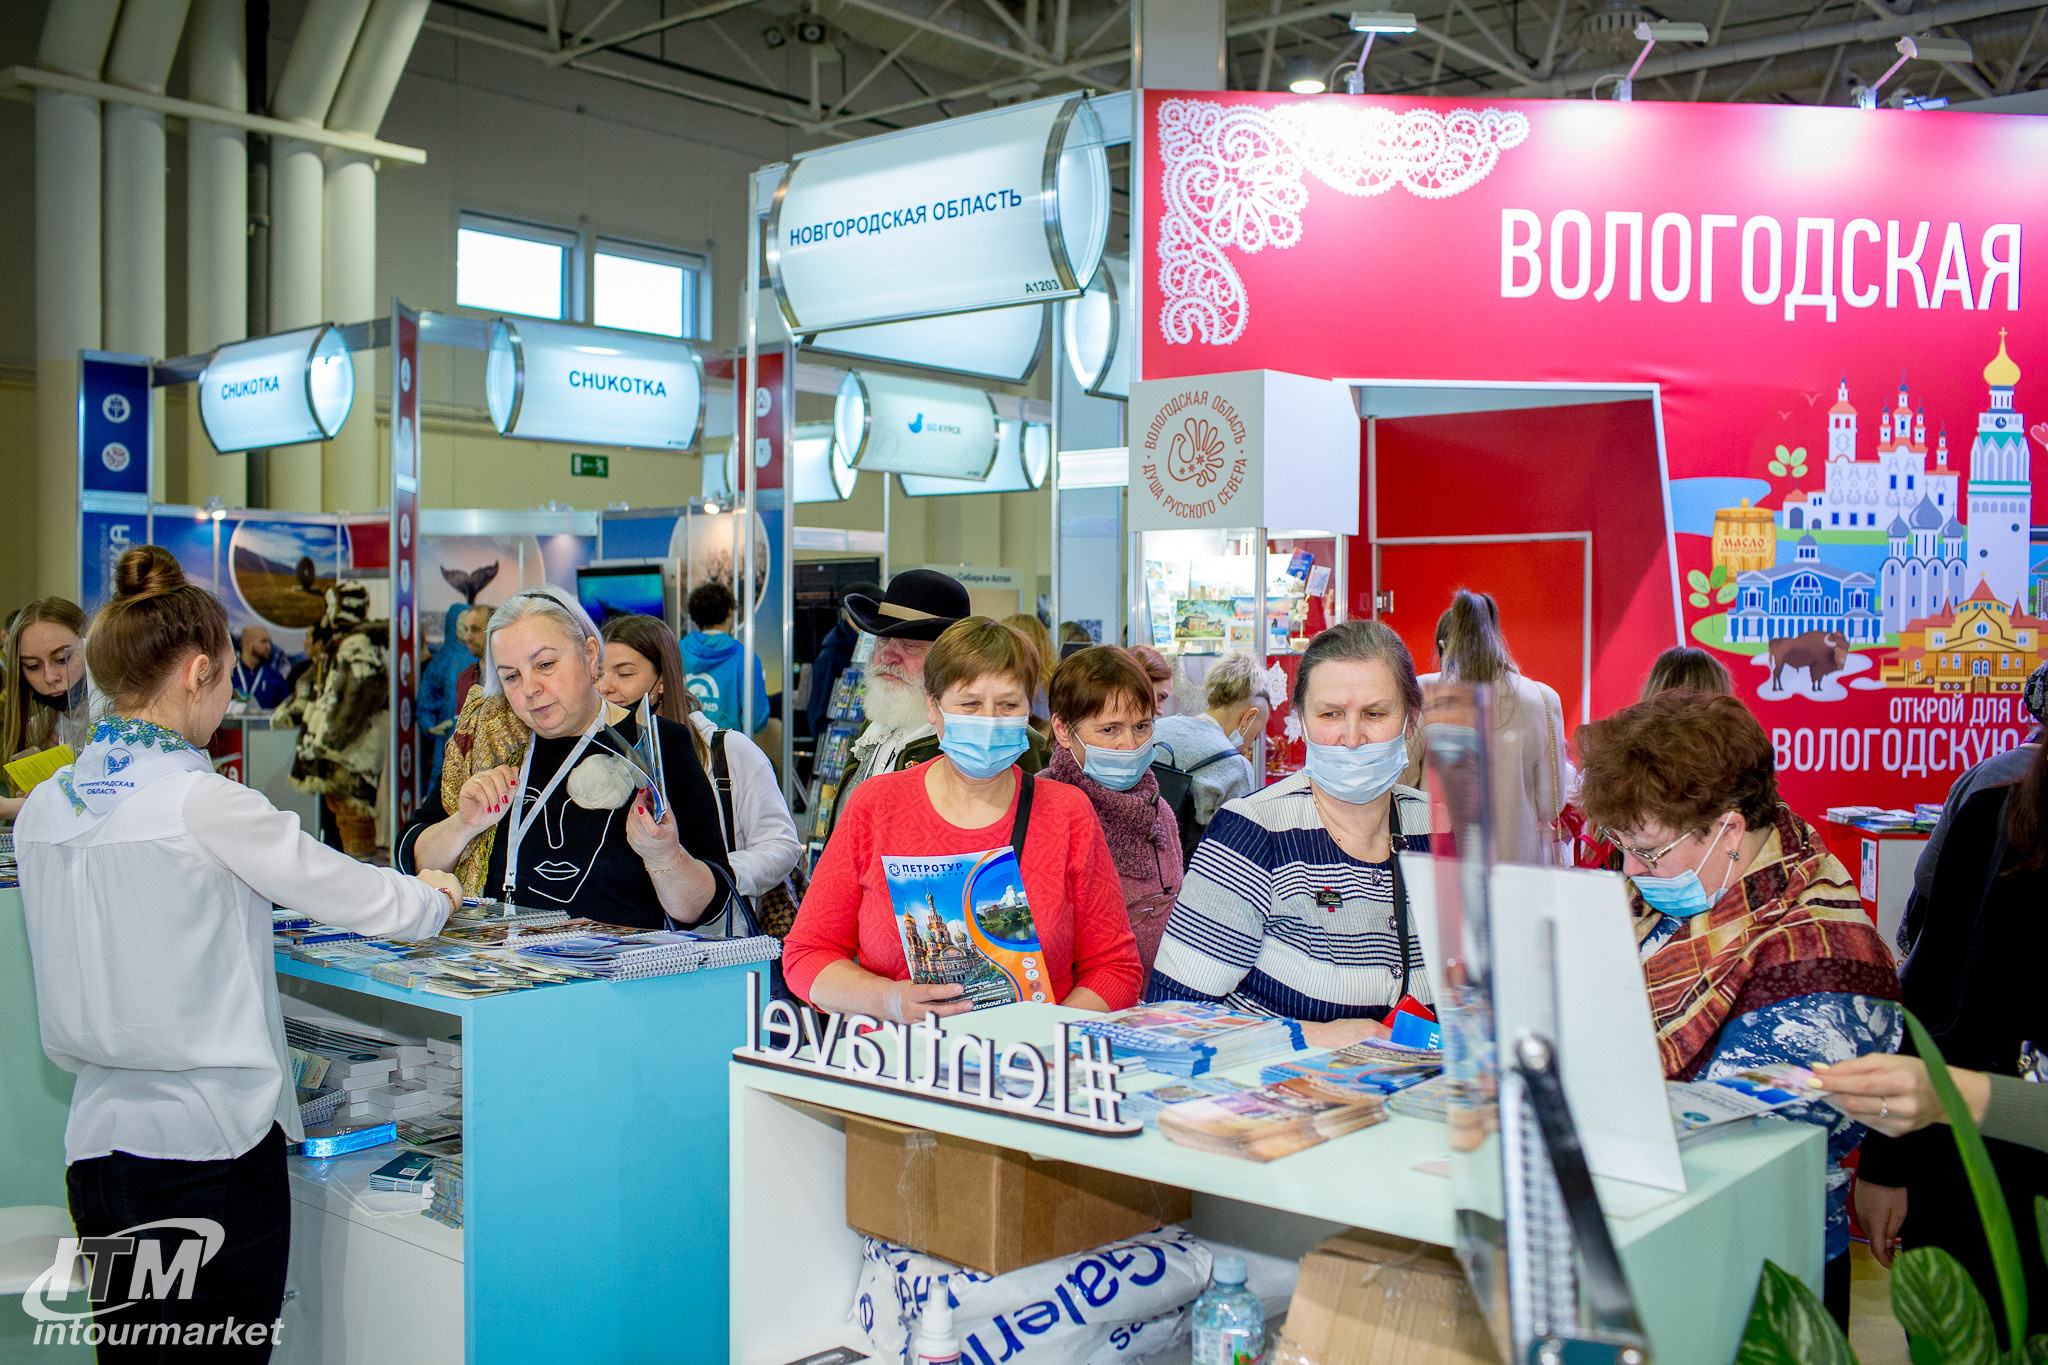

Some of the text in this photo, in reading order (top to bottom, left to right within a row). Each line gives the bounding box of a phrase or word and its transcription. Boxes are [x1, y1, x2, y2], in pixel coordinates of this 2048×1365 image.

[790, 188, 1022, 246] НОВГОРОДСКАЯ ОБЛАСТЬ
[1500, 208, 2023, 323] ВОЛОГОДСКАЯ
[1025, 279, 1060, 294] A1203
[221, 375, 279, 400] CHUKOTKA
[569, 369, 667, 397] CHUKOTKA
[1144, 390, 1247, 450] ВОЛОГОДСКАЯ ОБЛАСТЬ
[1142, 458, 1248, 519] ДУША РУССКОГО СЕВЕРА
[1721, 538, 1765, 548] МАСЛО
[1889, 693, 1964, 724] ОТКРОЙ
[1969, 697, 2011, 728] ДЛЯ
[1773, 727, 2020, 779] ВОЛОГОДСКУЮ
[902, 862, 963, 873] ПЕТРОТУР
